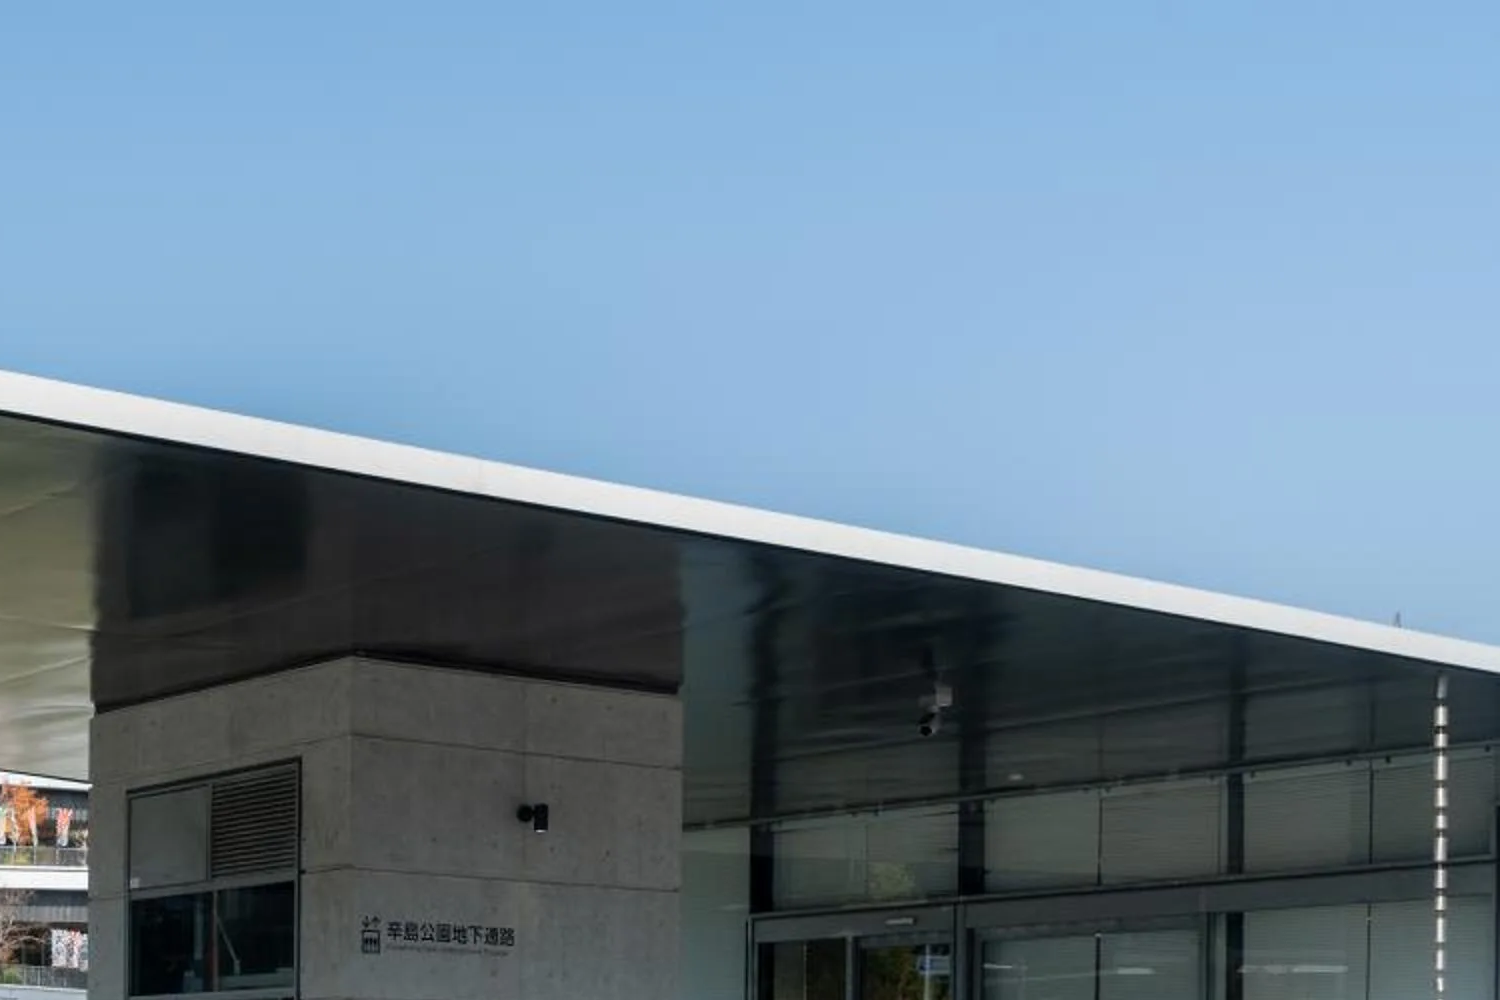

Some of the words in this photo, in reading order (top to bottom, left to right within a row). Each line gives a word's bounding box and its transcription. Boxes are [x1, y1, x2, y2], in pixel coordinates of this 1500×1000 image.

[387, 921, 515, 947] 辛島公園地下通路
